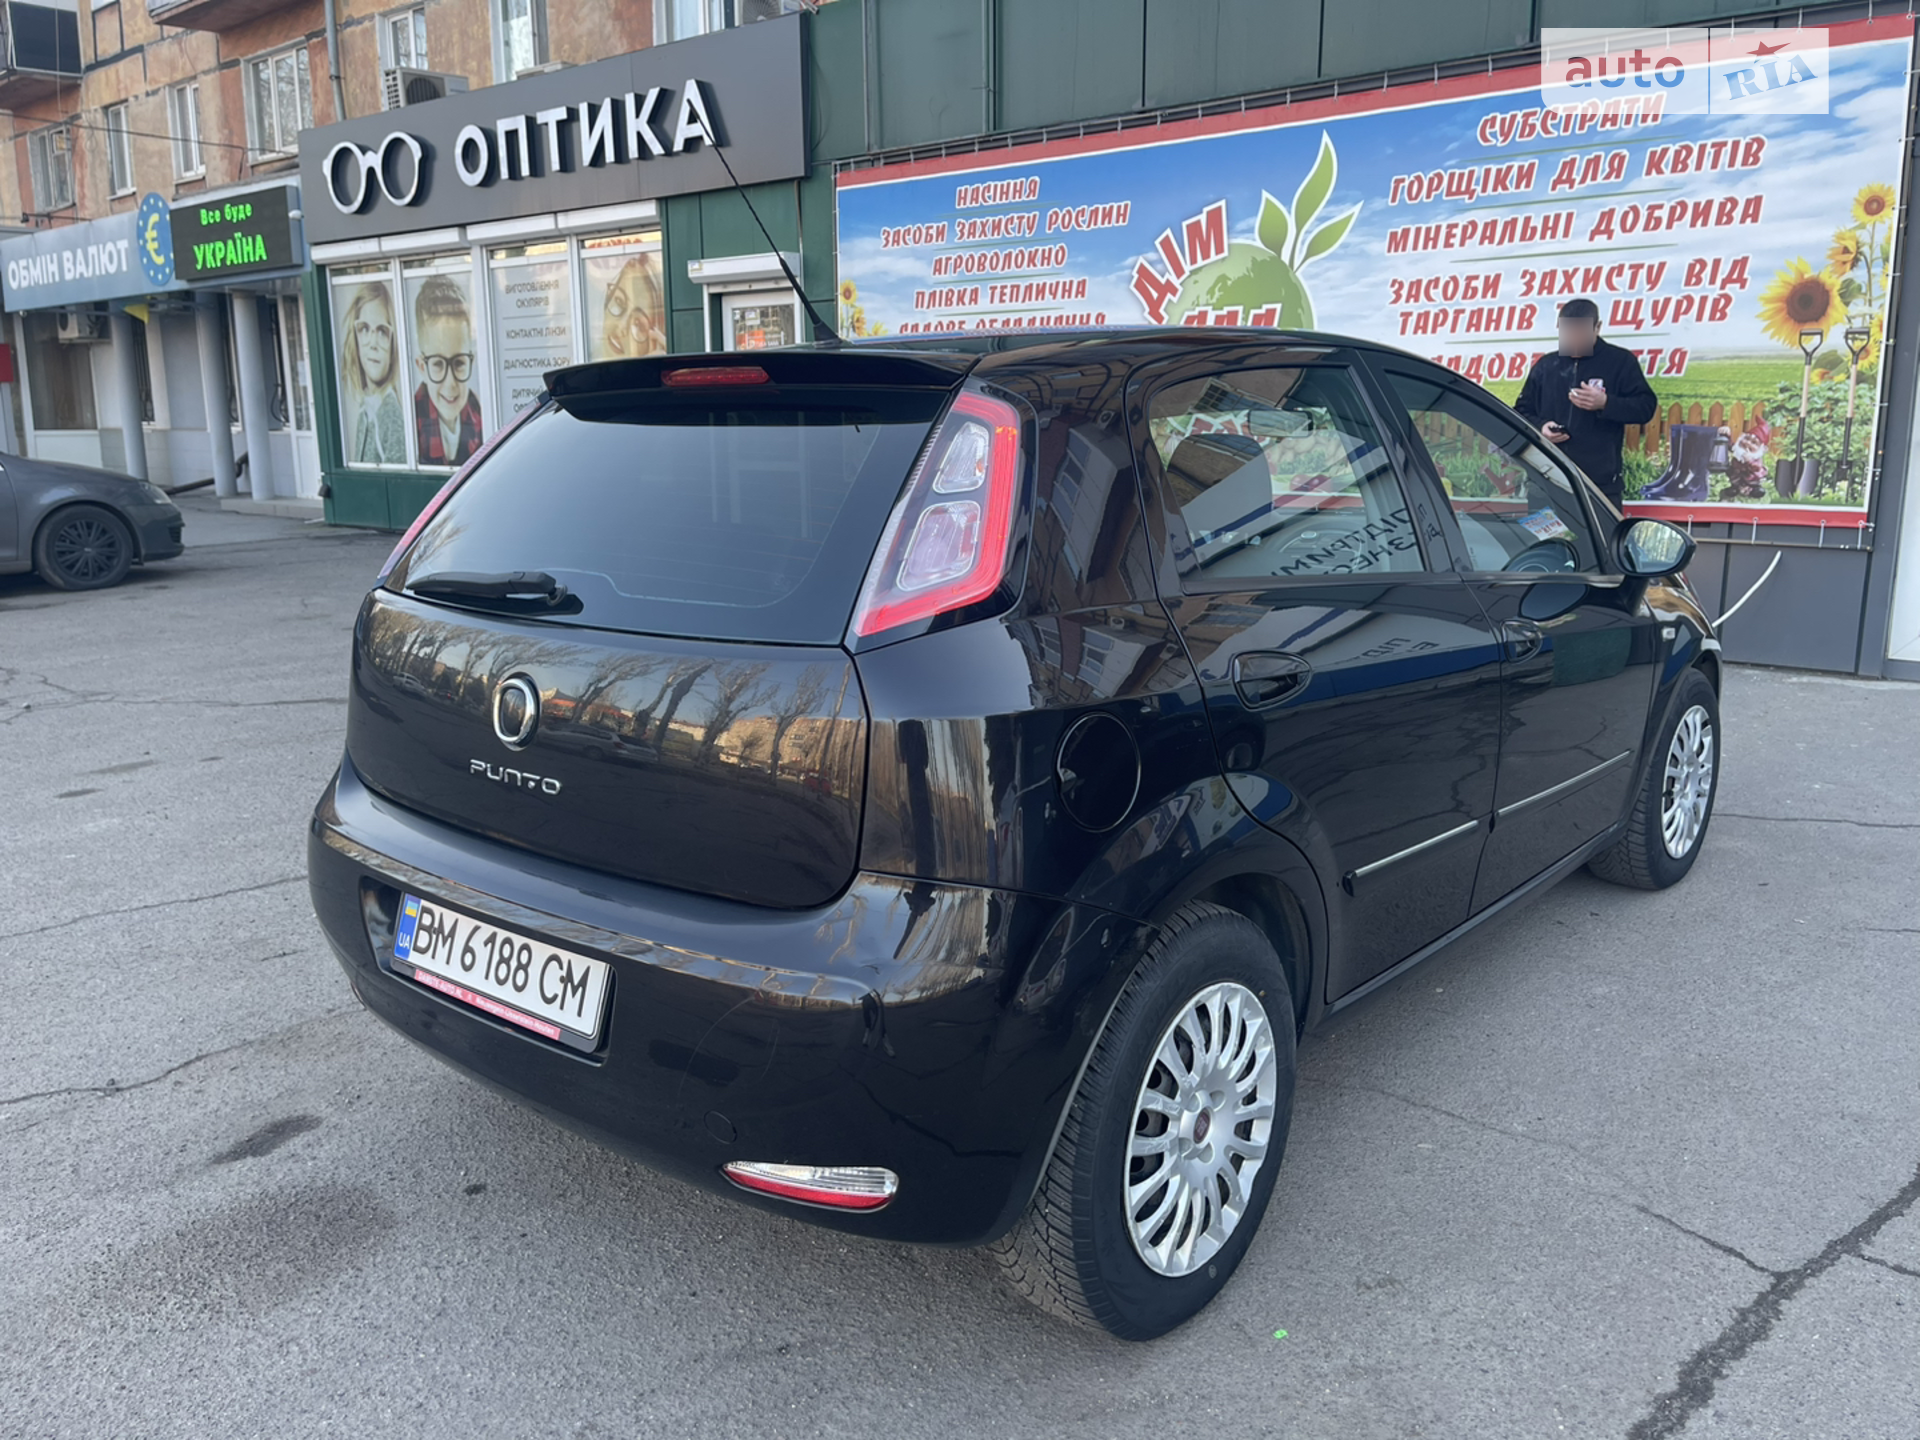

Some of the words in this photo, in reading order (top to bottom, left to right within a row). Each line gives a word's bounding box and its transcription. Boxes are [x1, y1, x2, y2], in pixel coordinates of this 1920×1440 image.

[455, 79, 718, 187] ОПТИКА
[1479, 95, 1666, 143] СУБСТРАТИ
[1391, 162, 1536, 203] ГОРЩІКИ
[1552, 153, 1628, 190] ДЛЯ
[1646, 137, 1765, 176] КВІТІВ
[200, 207, 221, 226] Все
[224, 203, 252, 223] буде
[957, 178, 1039, 207] НАСІННЯ
[882, 224, 948, 247] ЗАСОБИ
[956, 213, 1038, 240] ЗАХИСТУ
[1047, 203, 1131, 232] РОСЛИН
[1387, 211, 1575, 252] МІНЕРАЛЬНІ
[1589, 194, 1764, 241] ДОБРИВА
[8, 256, 58, 290] ОБМІН
[64, 239, 129, 278] ВАЛЮТ
[193, 232, 267, 270] УКРАЇНА
[933, 245, 1067, 276] АГРОВОЛОКНО
[1131, 201, 1228, 325] ДІМ
[914, 287, 980, 309] ПЛІВКА
[989, 278, 1087, 304] ТЕПЛИЧНА
[1389, 273, 1501, 304] ЗАСОБИ
[1519, 261, 1667, 296] ЗАХИСТУ
[1684, 255, 1751, 290] ВІД
[1400, 304, 1537, 335] ТАРГАНІВ
[1609, 293, 1733, 330] ЩУРІВ
[470, 759, 562, 795] PUNTO
[398, 931, 411, 949] UA
[460, 924, 533, 993] 6188
